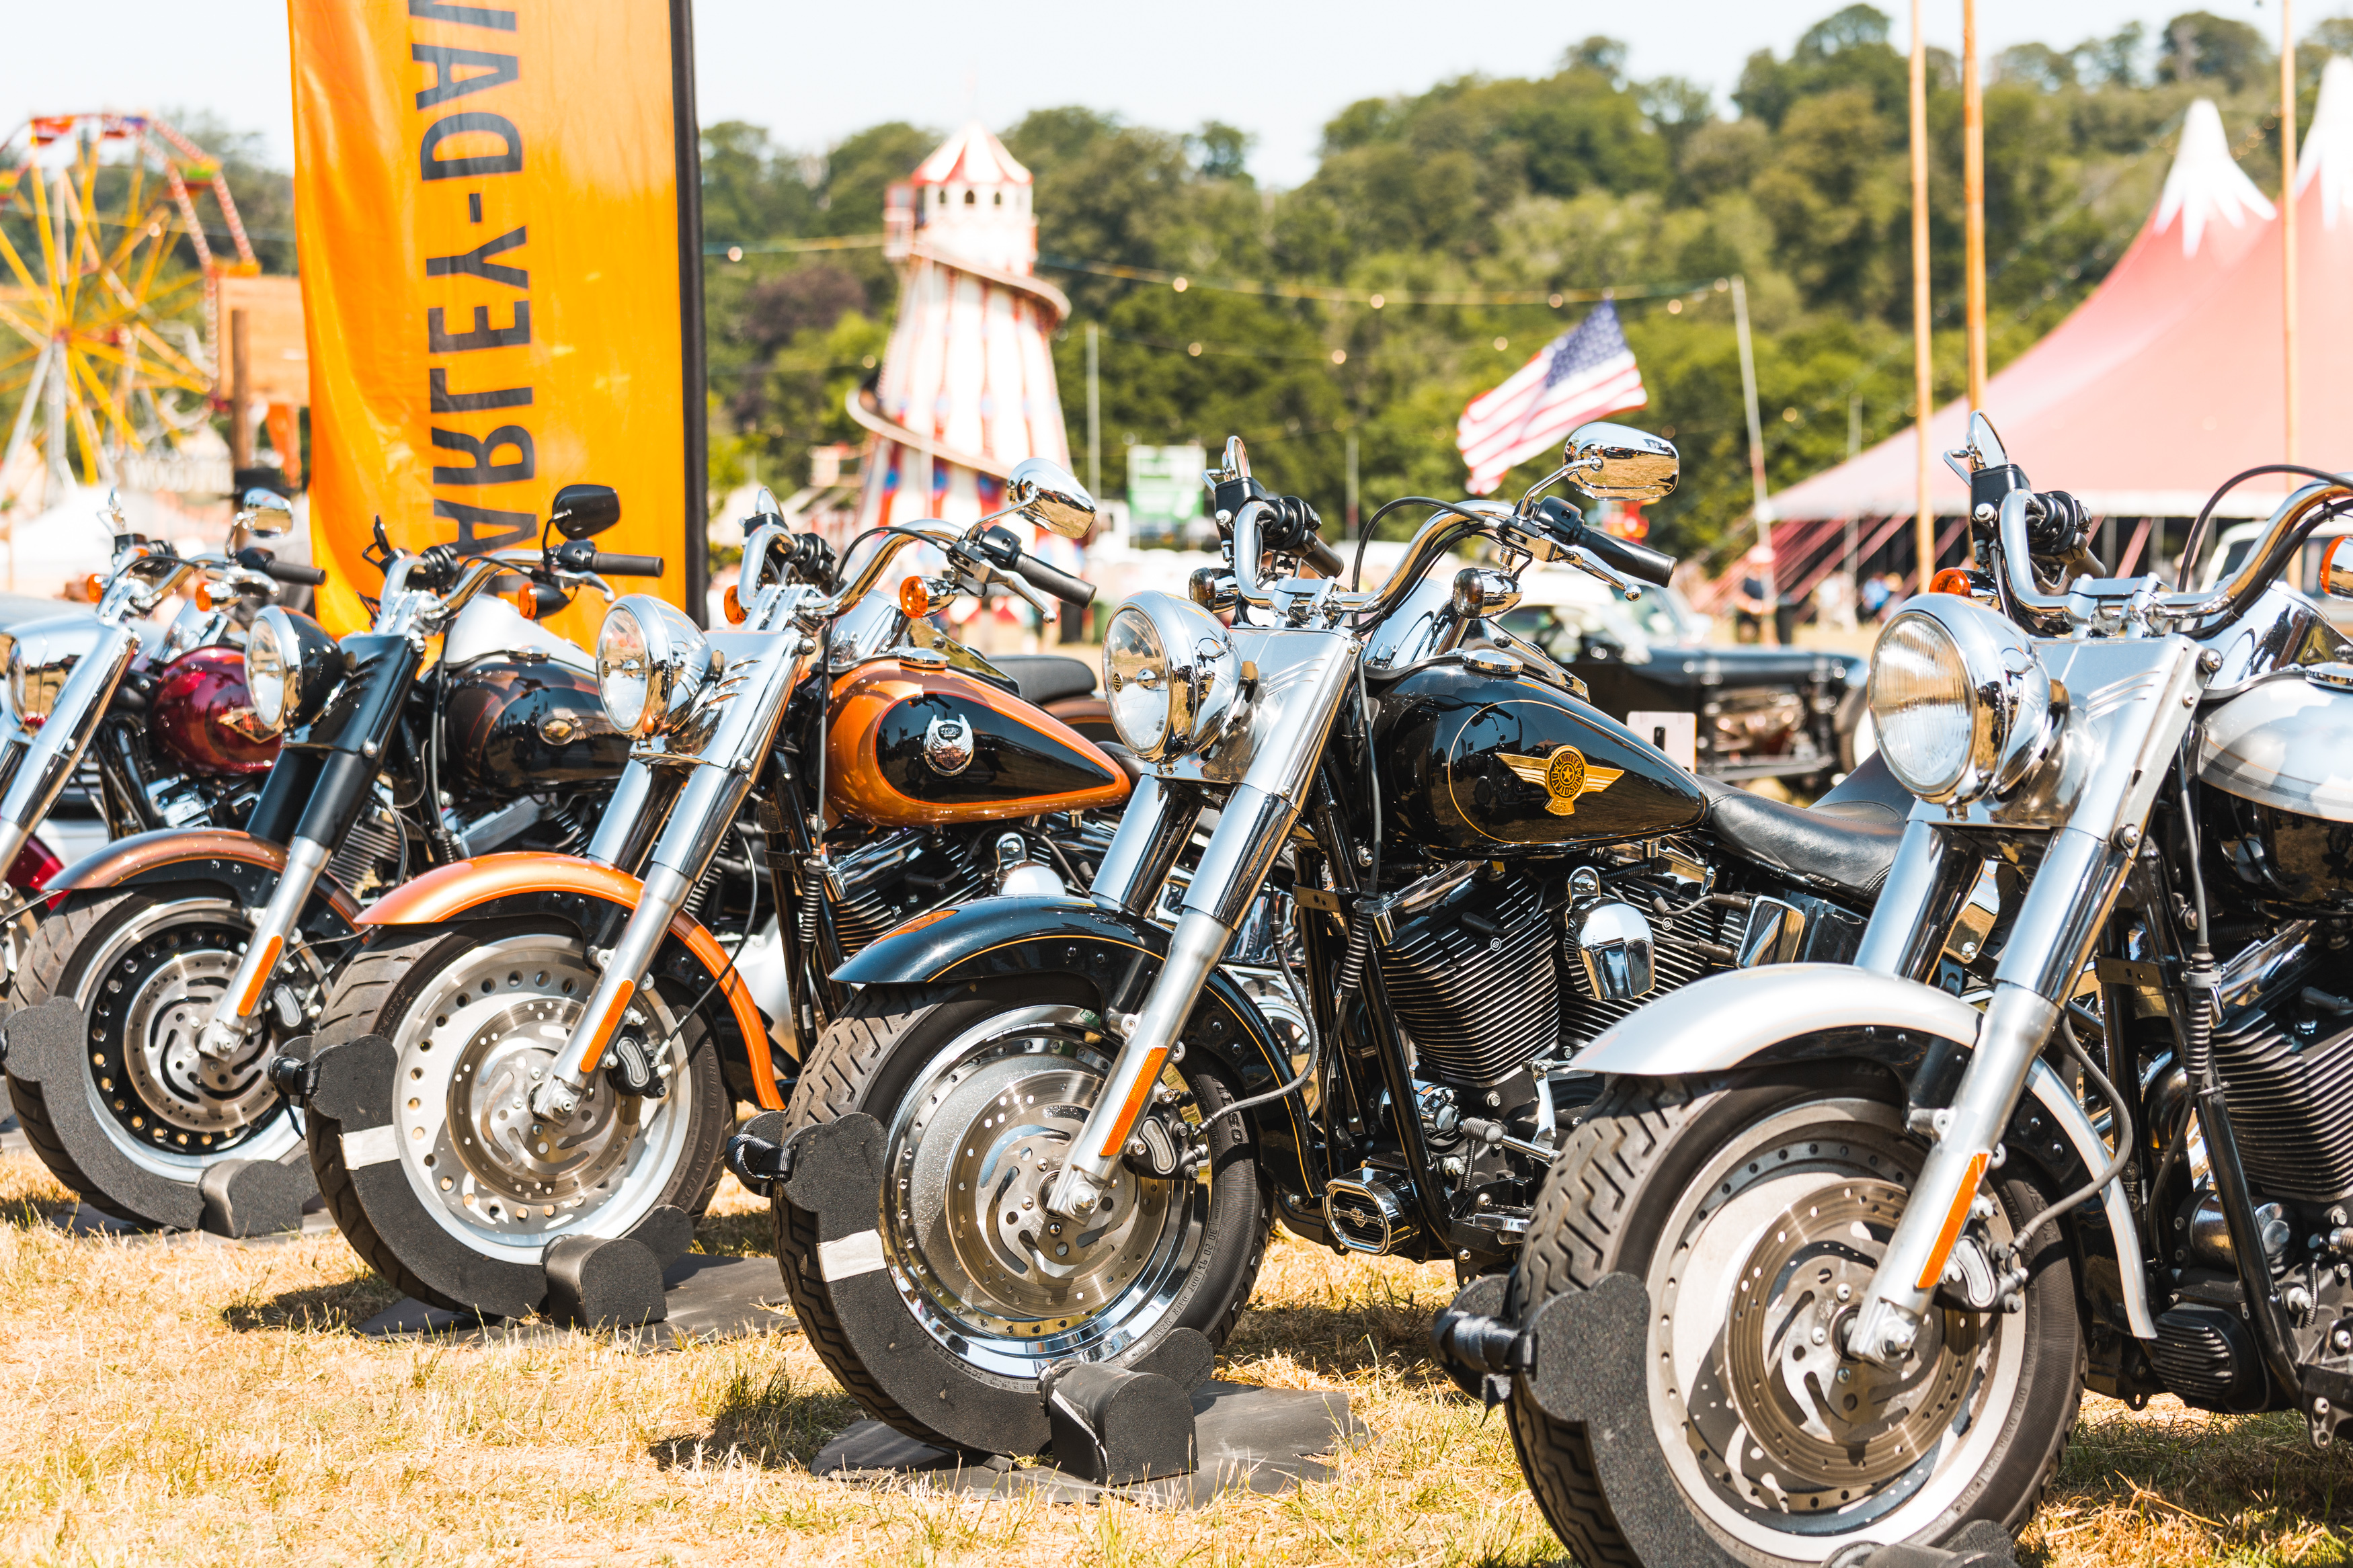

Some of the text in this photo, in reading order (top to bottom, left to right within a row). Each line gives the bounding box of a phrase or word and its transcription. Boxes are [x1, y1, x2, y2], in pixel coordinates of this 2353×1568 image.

[1554, 752, 1583, 771] HARLEY
[1552, 772, 1583, 797] DAVIDSON
[1149, 1126, 1168, 1163] HARLEY-DAVIDSON
[1209, 1229, 1218, 1241] 30
[1203, 1243, 1213, 1255] 20
[1188, 1275, 1201, 1292] DOT
[1172, 1295, 1190, 1315] DATR
[2016, 1387, 2028, 1412] DOT
